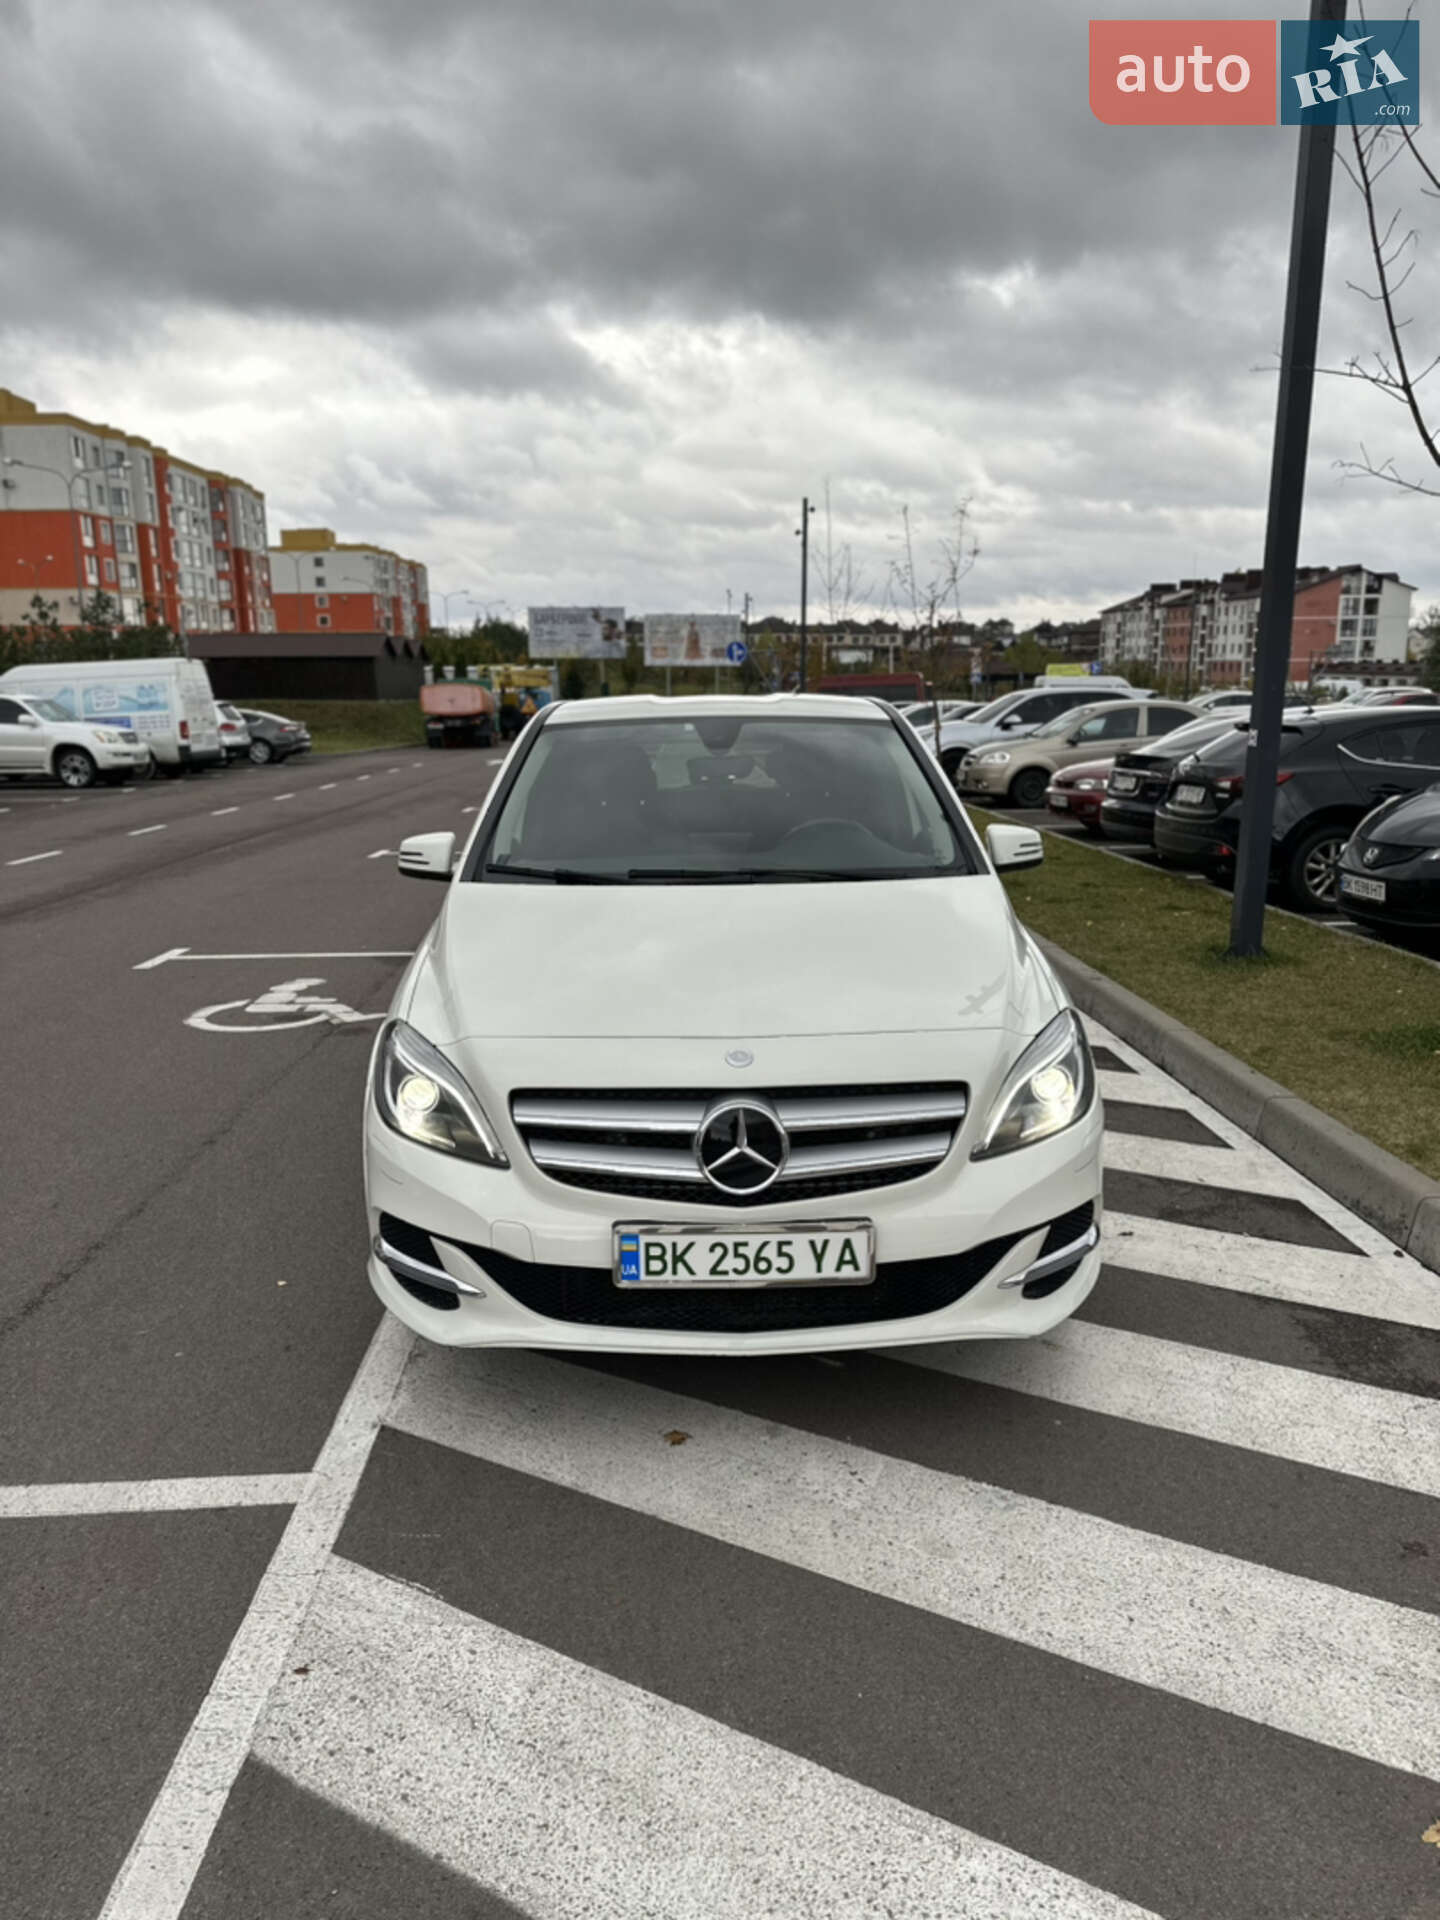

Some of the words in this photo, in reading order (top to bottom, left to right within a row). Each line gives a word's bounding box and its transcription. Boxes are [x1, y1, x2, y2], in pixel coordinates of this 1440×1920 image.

[644, 1241, 697, 1276] BK
[708, 1240, 795, 1276] 2565
[808, 1238, 861, 1273] YA
[621, 1264, 638, 1276] UA
